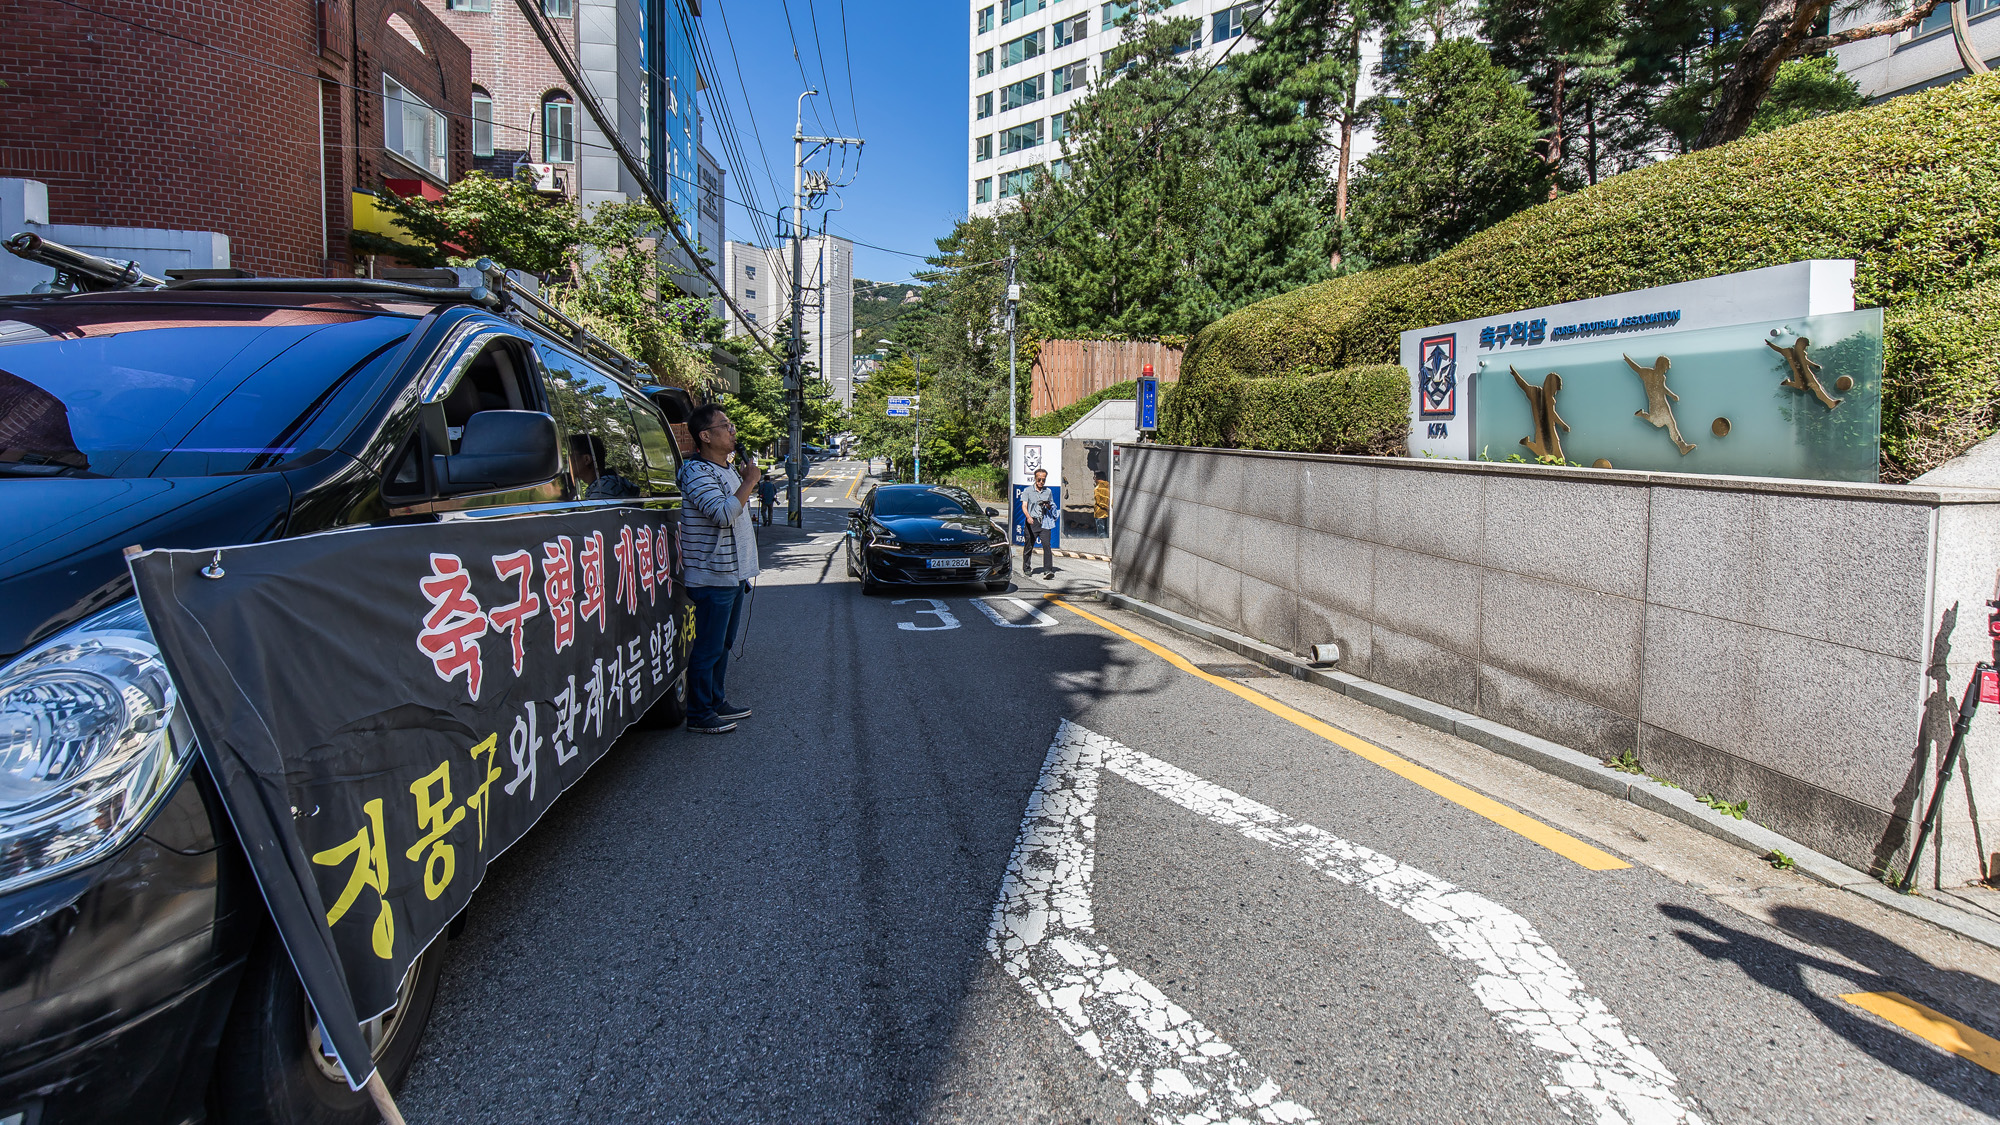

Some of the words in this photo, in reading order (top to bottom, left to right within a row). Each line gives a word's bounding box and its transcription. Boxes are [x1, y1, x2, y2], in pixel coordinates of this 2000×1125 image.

[1481, 317, 1547, 345] 축구회관
[1552, 324, 1578, 336] KOREA
[1578, 318, 1619, 332] FOOTBALL
[1620, 309, 1681, 327] ASSOCIATION
[1428, 422, 1448, 437] KFA
[952, 559, 968, 567] 2824
[417, 530, 605, 702] 축구협회
[614, 524, 672, 615] 개혁의
[891, 597, 1058, 630] 30
[313, 701, 543, 959] 정몽규와
[552, 635, 644, 765] 관계자들
[650, 614, 677, 685] 일괄
